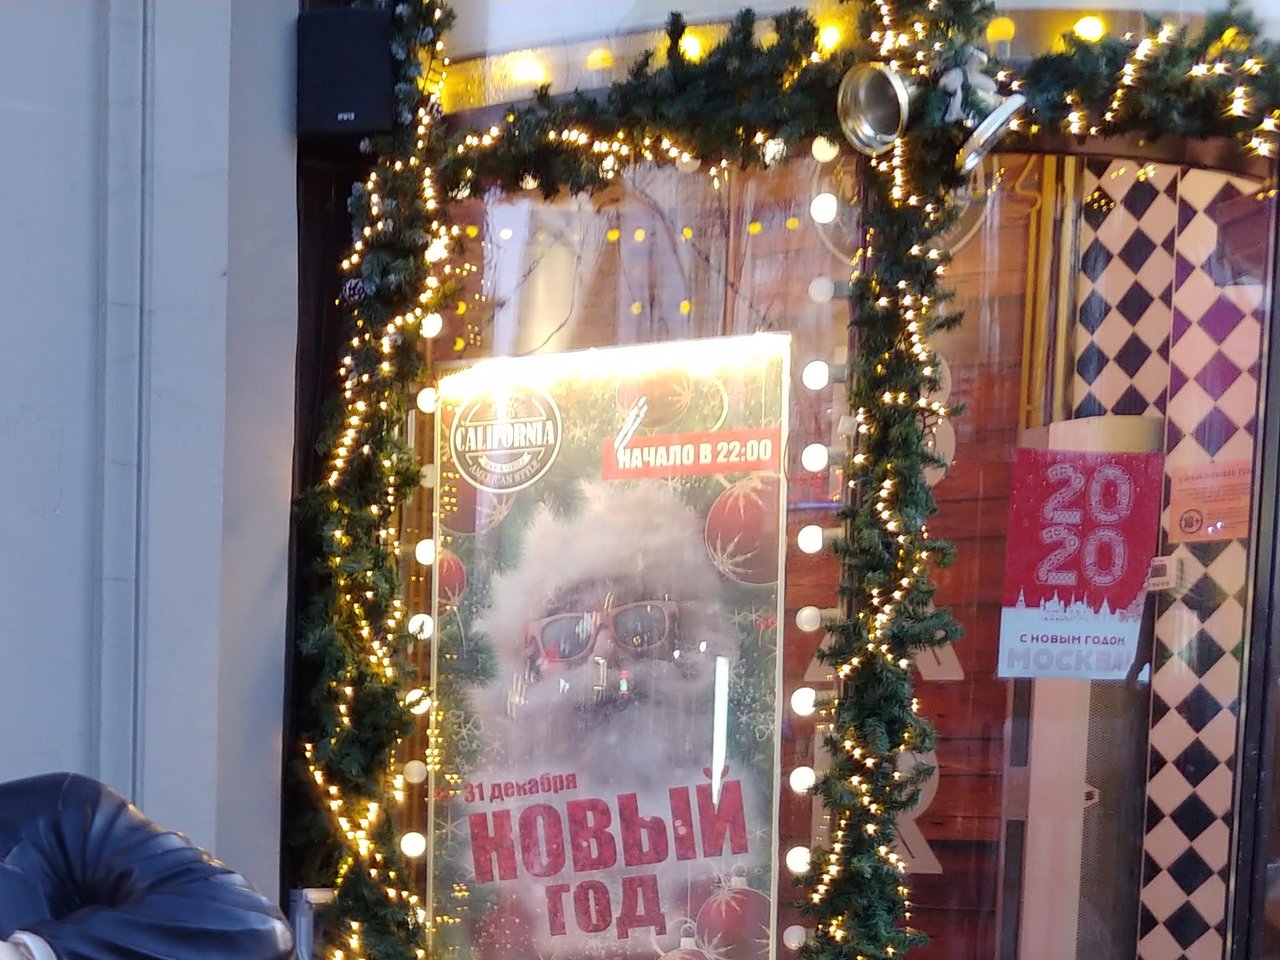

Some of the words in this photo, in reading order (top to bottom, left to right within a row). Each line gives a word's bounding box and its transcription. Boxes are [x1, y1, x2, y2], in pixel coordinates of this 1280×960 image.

[455, 420, 555, 452] CALIFORNIA
[617, 443, 695, 470] НАЧАЛО
[699, 443, 713, 465] В
[716, 439, 773, 464] 22:00
[1031, 634, 1081, 645] НОВЫМ
[464, 782, 485, 803] 31
[489, 772, 577, 803] декабря
[468, 766, 749, 883] НОВЫЙ
[545, 874, 667, 940] ГОД
